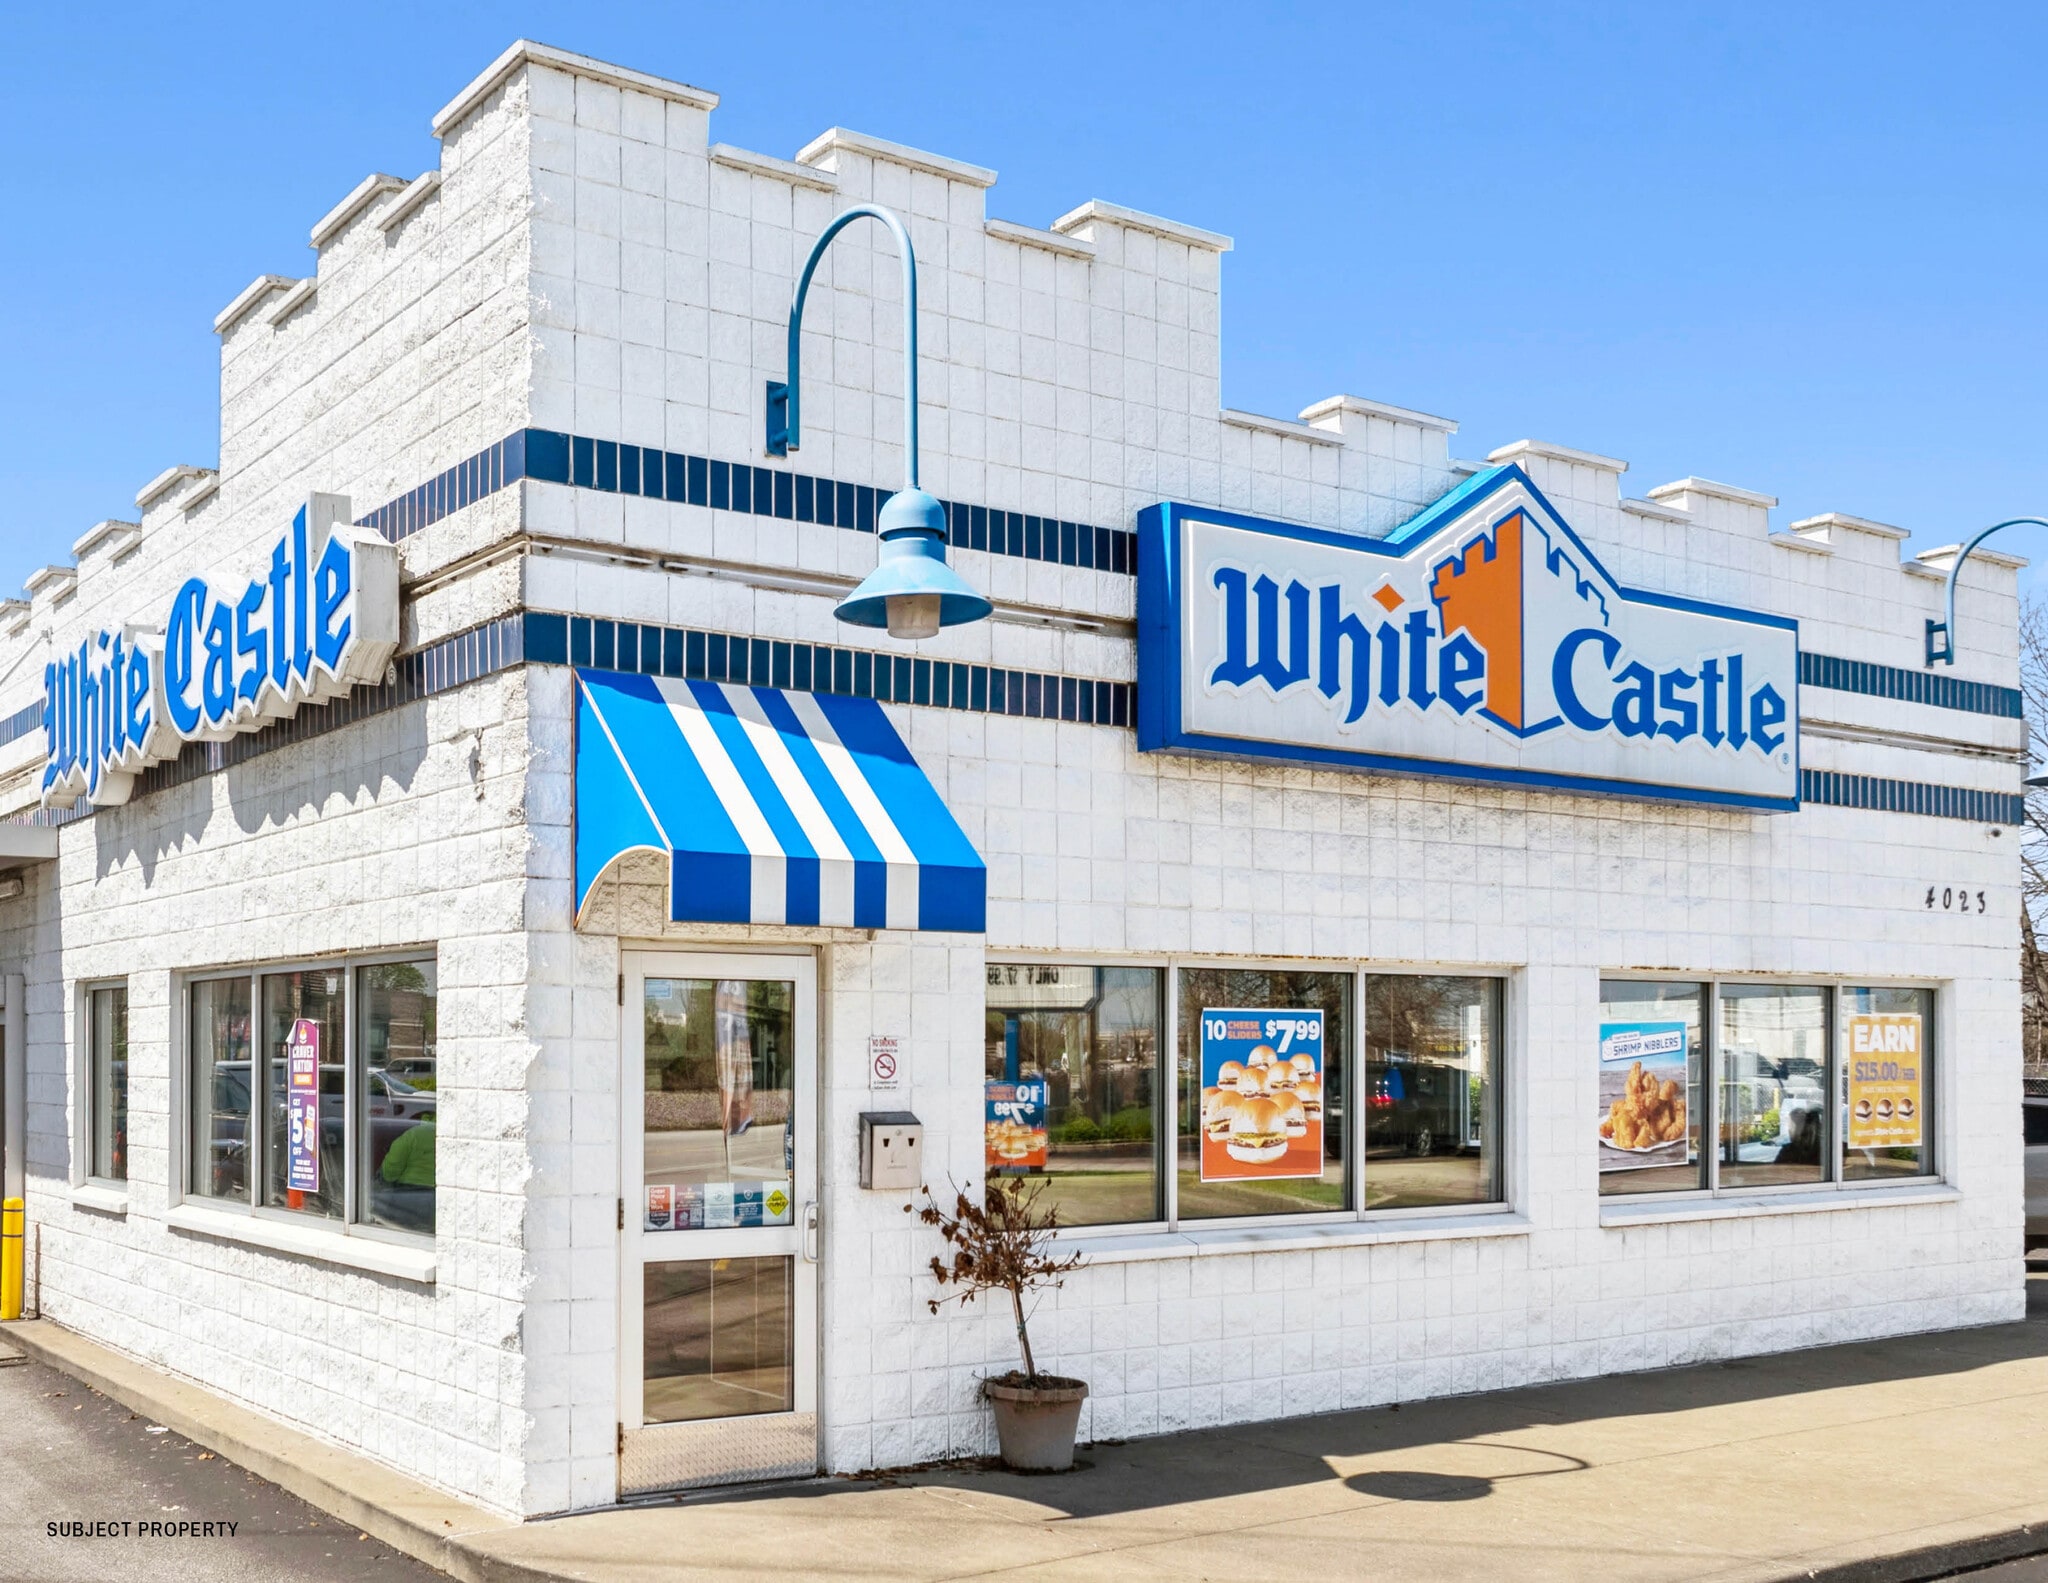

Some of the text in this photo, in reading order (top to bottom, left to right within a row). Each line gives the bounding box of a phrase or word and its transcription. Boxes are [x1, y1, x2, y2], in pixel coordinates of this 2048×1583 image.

[42, 501, 351, 796] White Castle
[1212, 567, 1786, 755] White Castle
[1925, 886, 1985, 914] 4023
[1205, 1020, 1226, 1041] 10
[1227, 1021, 1259, 1030] CHEESE
[1227, 1031, 1262, 1040] SLIDERS
[1854, 1024, 1916, 1053] EARN
[1613, 1037, 1679, 1057] SHRIMP NIBBLERS
[1855, 1062, 1898, 1082] $15.00
